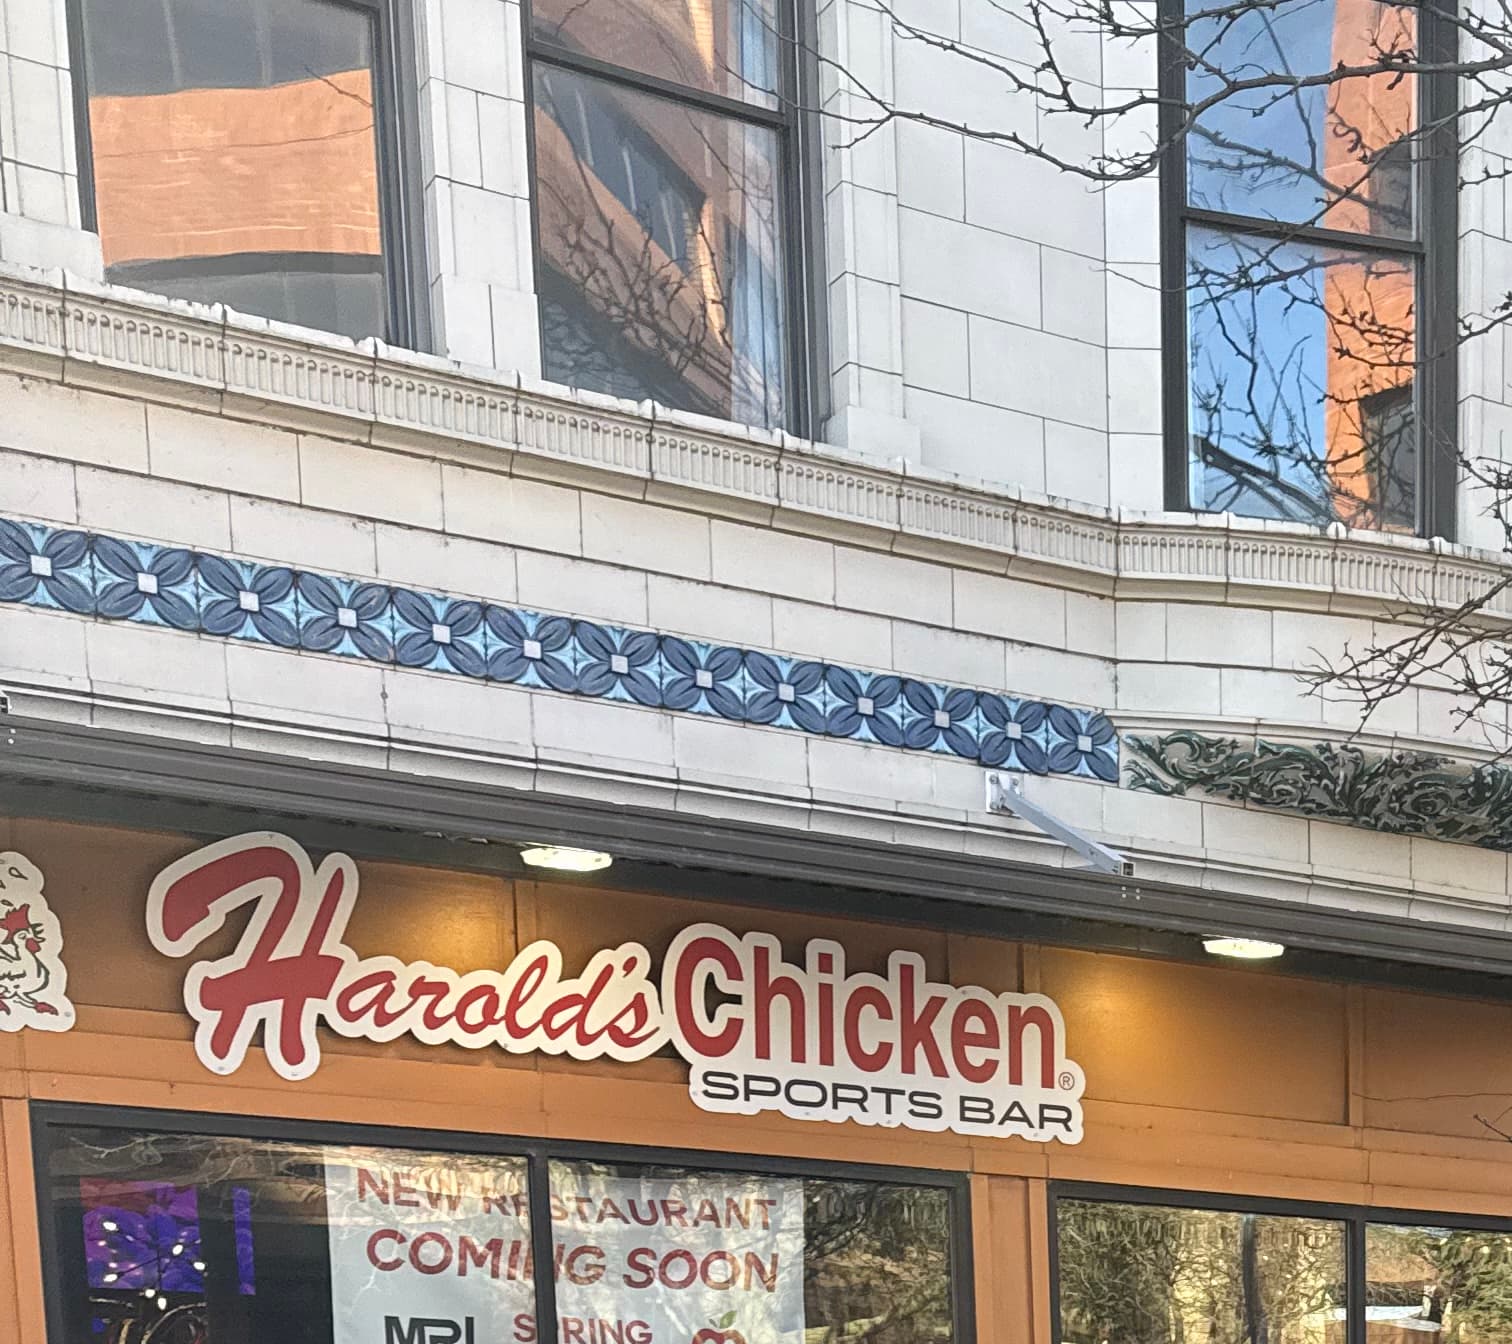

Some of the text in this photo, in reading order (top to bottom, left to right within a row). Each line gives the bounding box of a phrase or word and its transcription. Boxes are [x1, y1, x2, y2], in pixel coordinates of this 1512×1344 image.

[162, 846, 1056, 1090] Harold's Chicken
[701, 1070, 1073, 1133] SPORTS BAR
[357, 1168, 463, 1211] NEW
[623, 1247, 779, 1293] SOON
